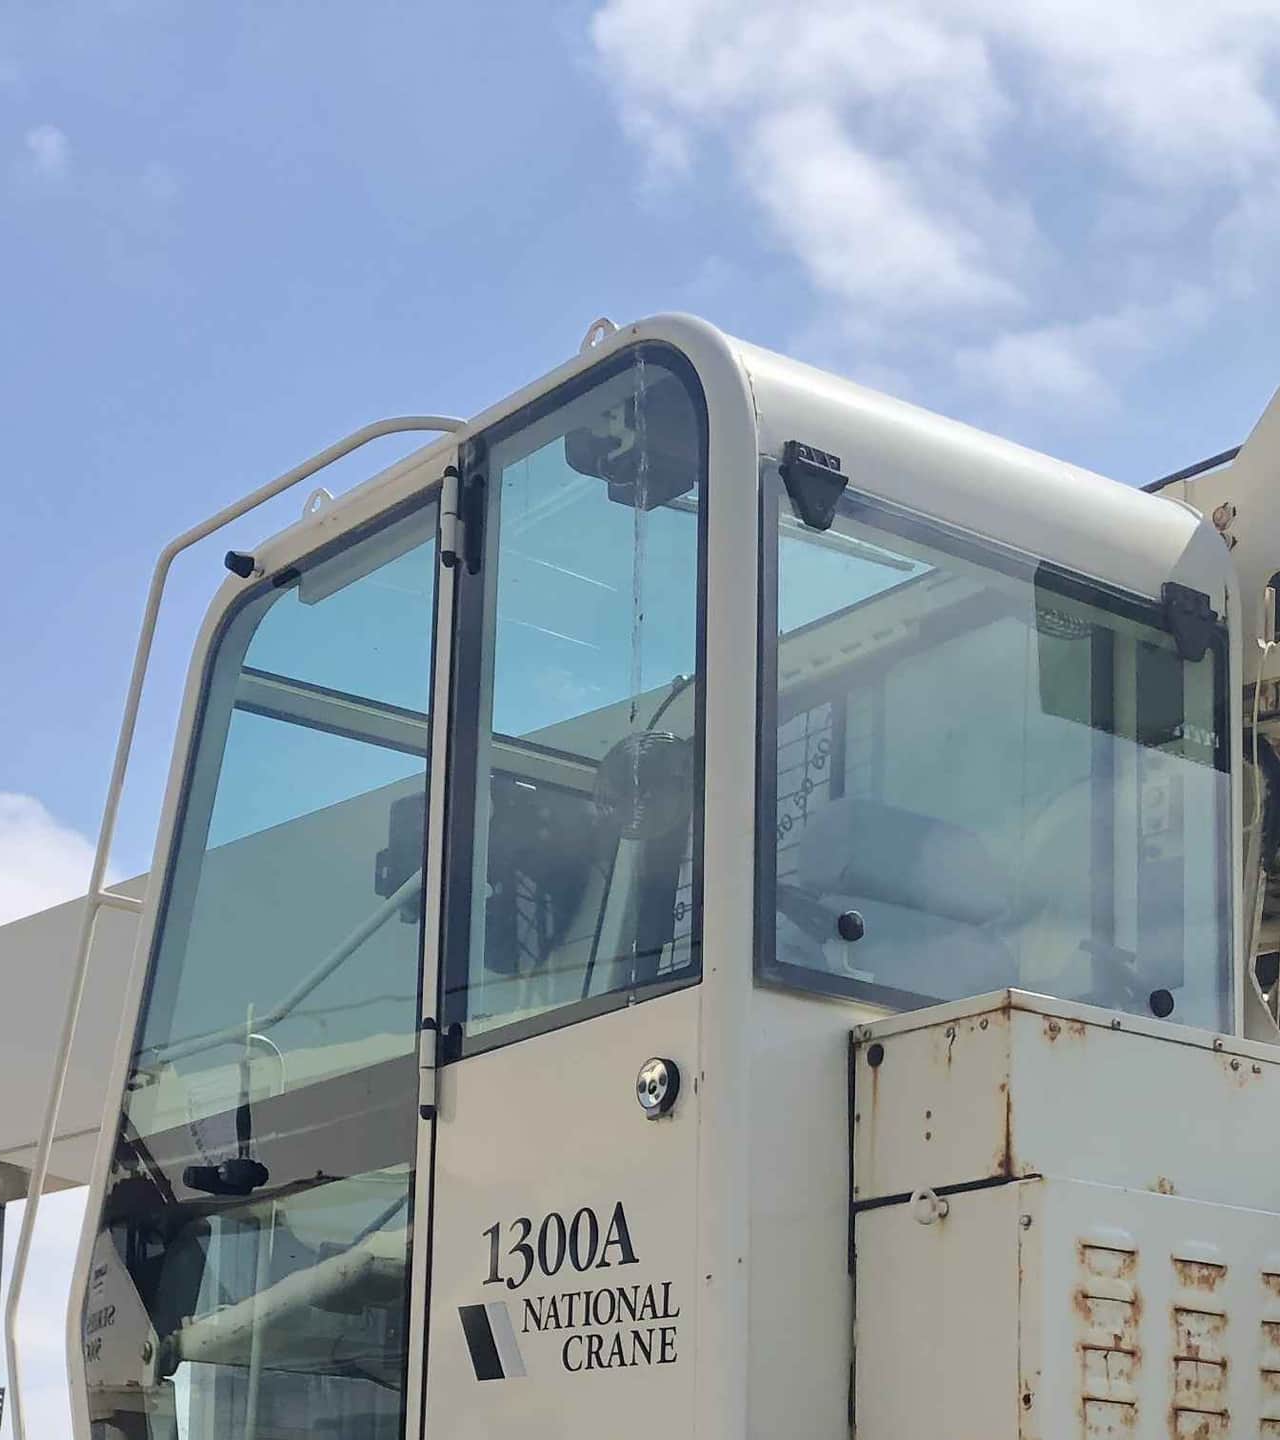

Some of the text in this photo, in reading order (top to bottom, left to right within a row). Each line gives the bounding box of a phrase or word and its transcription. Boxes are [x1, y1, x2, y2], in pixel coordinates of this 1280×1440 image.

[482, 1201, 640, 1290] 1300A
[521, 1281, 681, 1333] NATIONAL
[561, 1326, 679, 1373] CRANE
